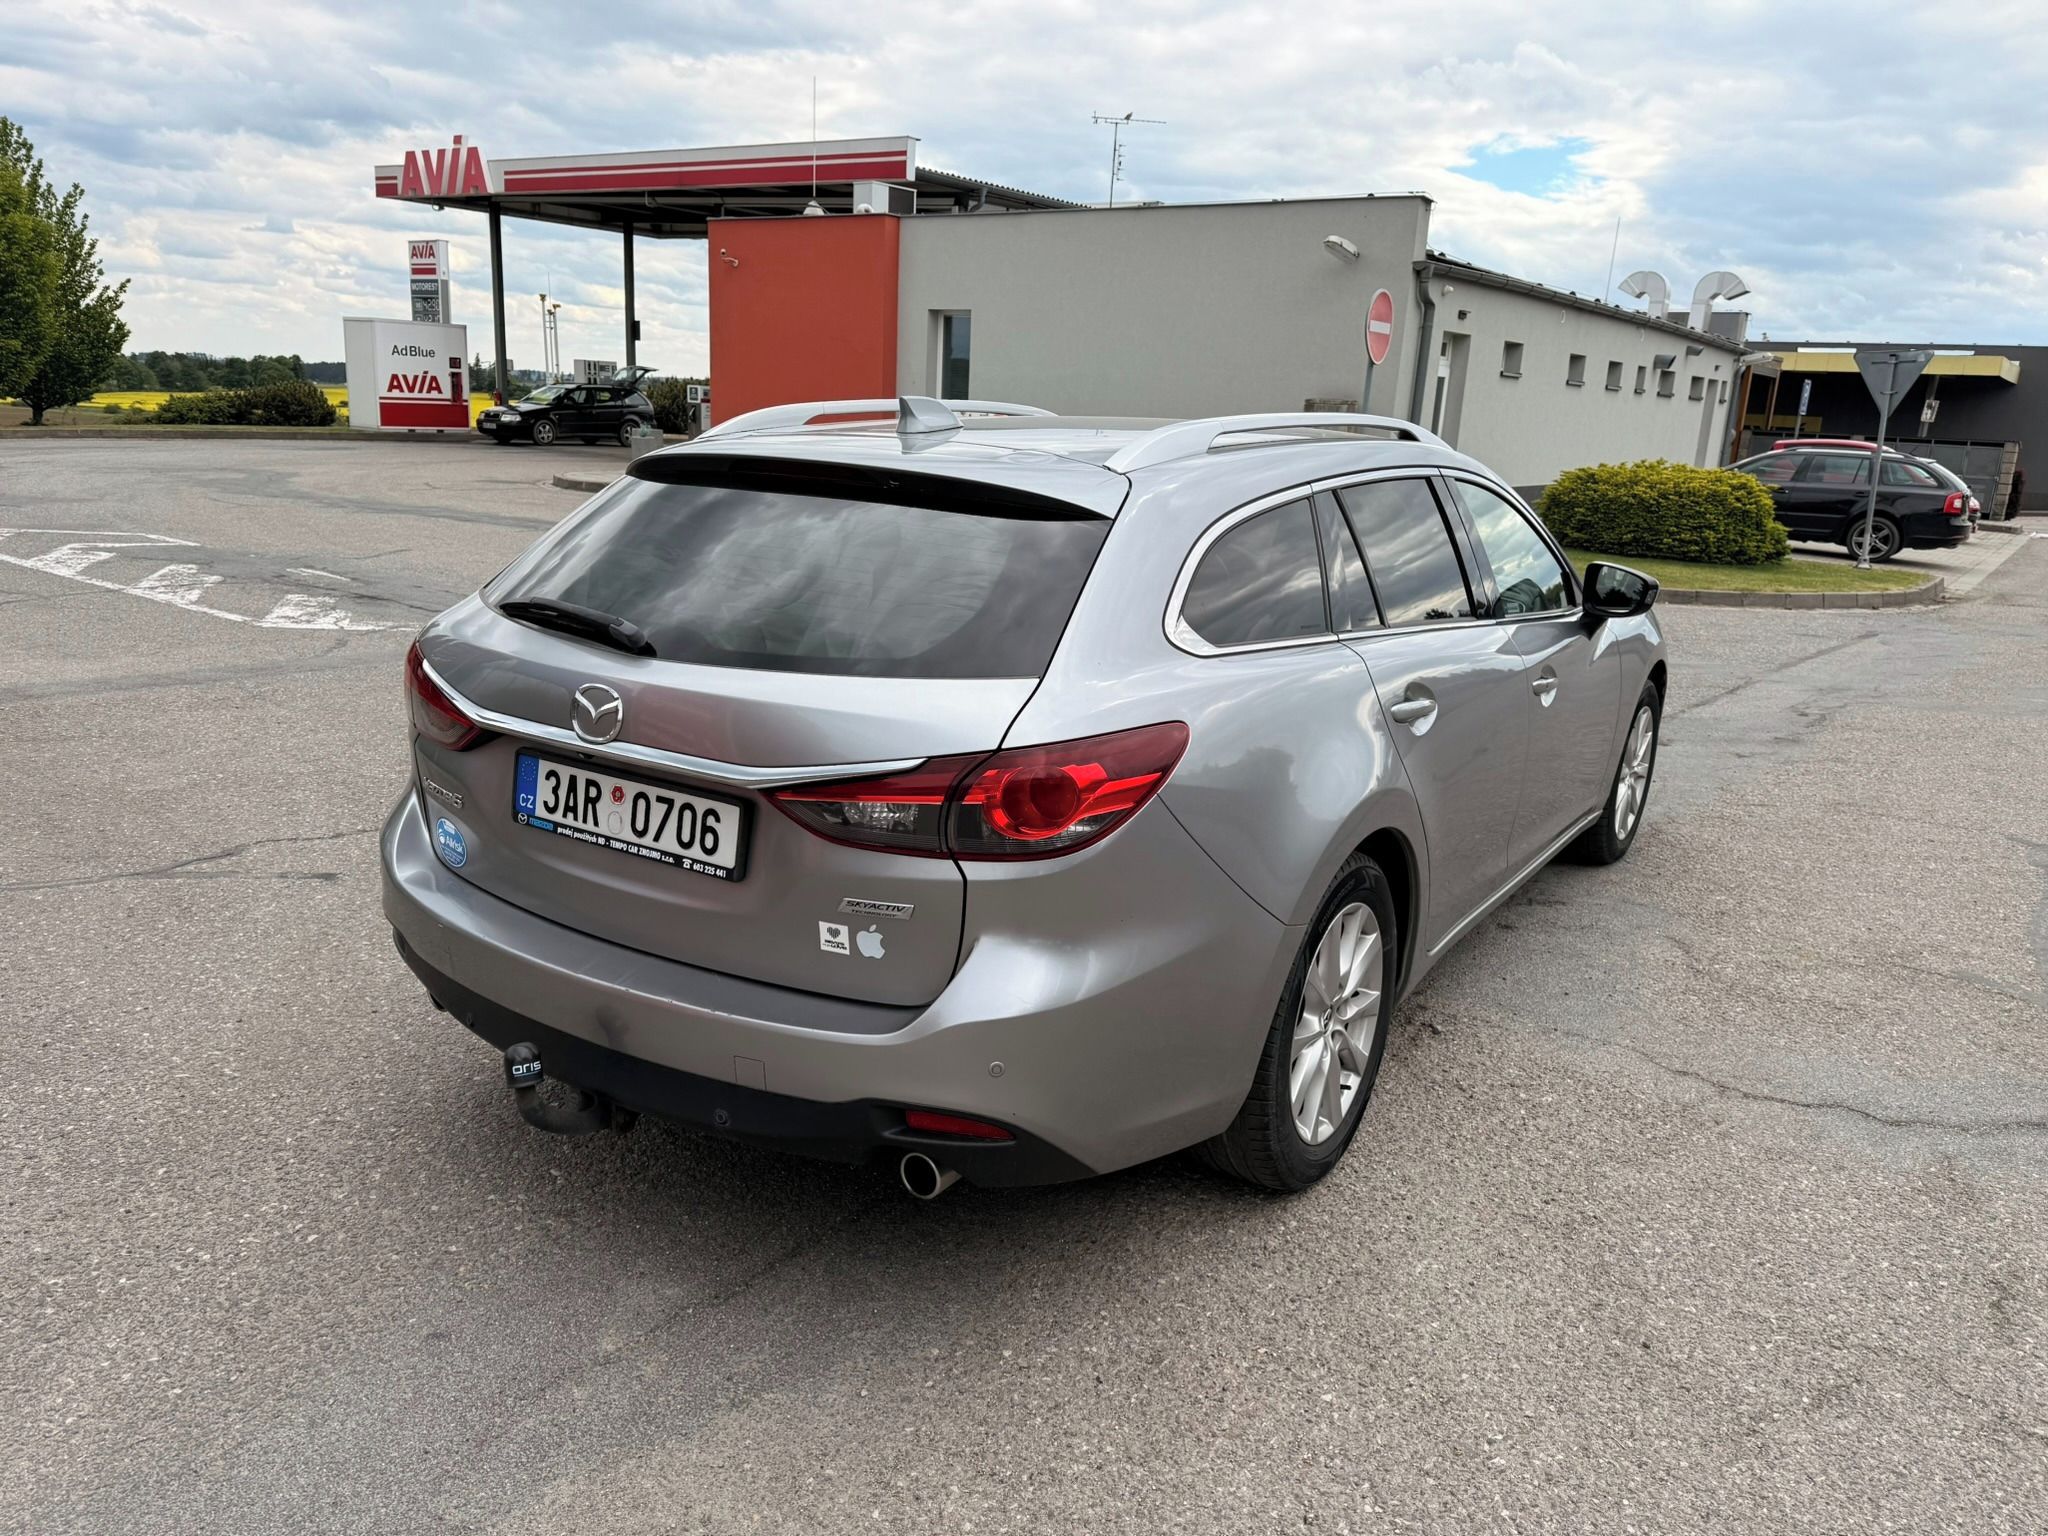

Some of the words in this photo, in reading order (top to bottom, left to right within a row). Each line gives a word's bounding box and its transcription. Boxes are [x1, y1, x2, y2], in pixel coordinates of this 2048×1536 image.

[391, 345, 436, 358] AdBlue
[519, 793, 534, 809] CZ
[543, 769, 602, 828] 3AR
[630, 791, 721, 857] 0706
[609, 839, 627, 851] TEMPO
[628, 844, 638, 855] CAR
[638, 847, 661, 860] ZNOJMO
[846, 900, 906, 913] SKYACTIV
